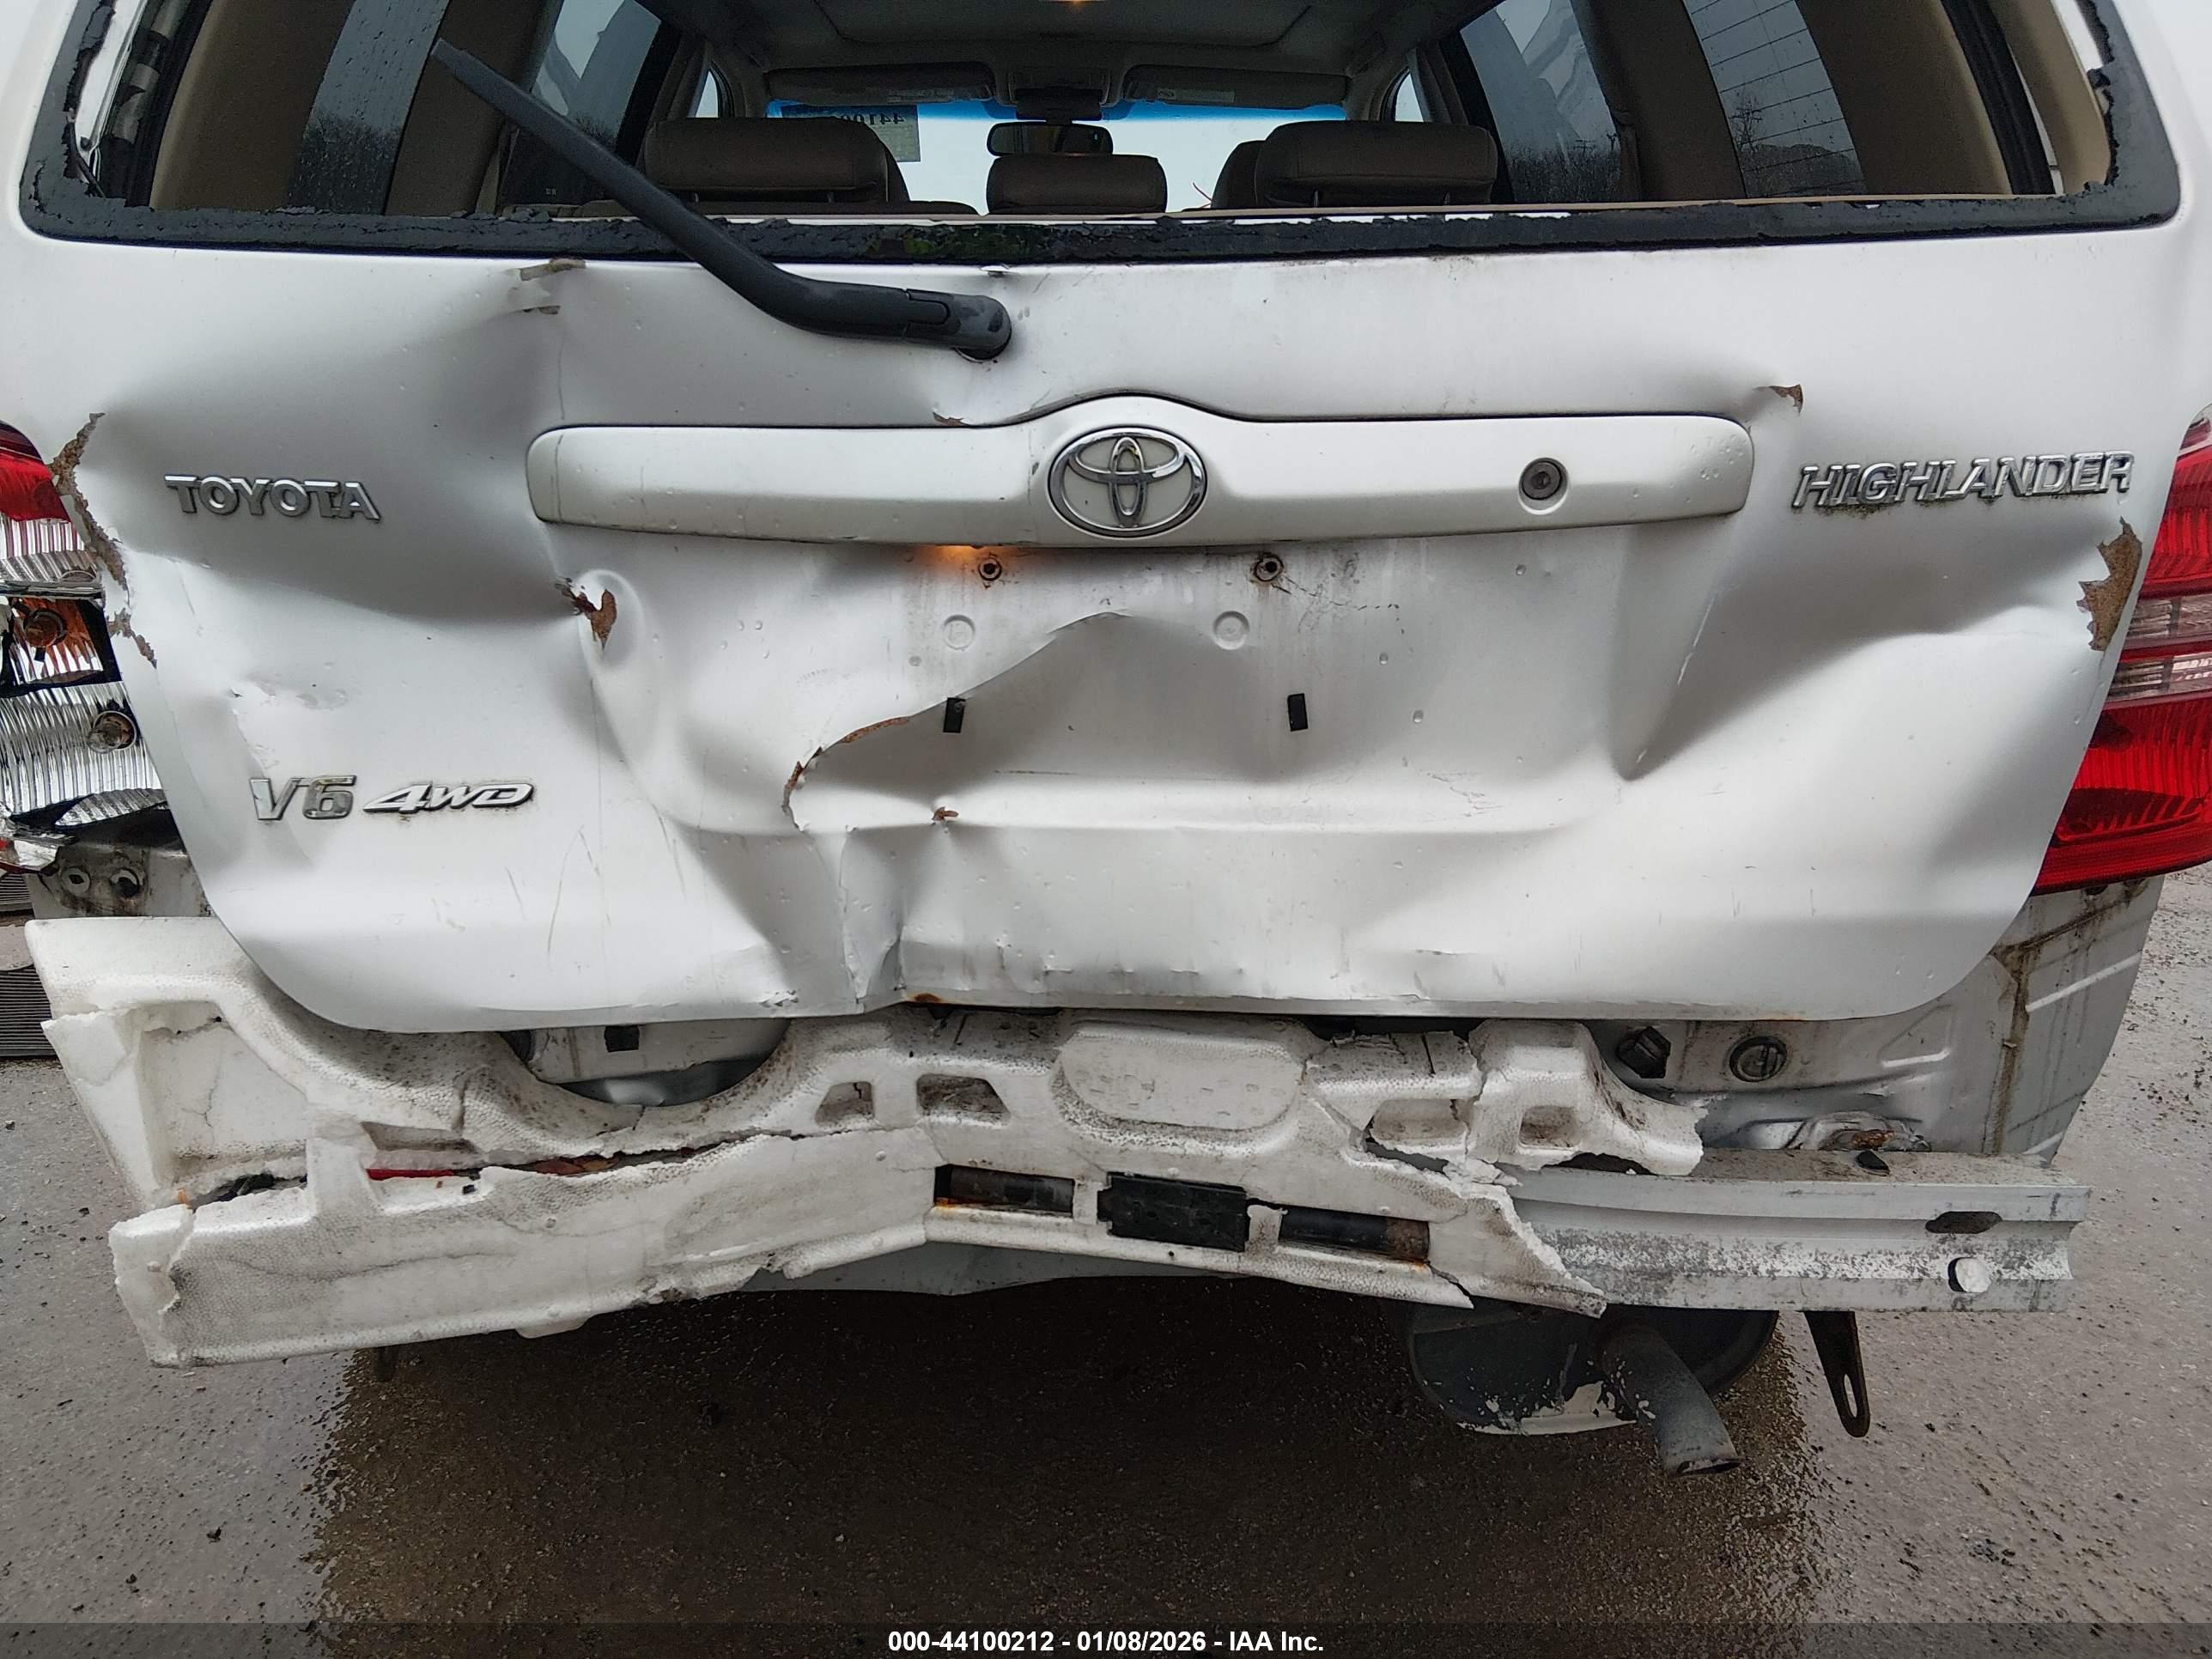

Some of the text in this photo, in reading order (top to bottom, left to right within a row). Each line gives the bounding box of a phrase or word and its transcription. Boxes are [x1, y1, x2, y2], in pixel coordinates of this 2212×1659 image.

[164, 474, 381, 522] TOYOTA
[1791, 451, 2135, 509] HIGHLANDER
[249, 775, 535, 820] V6 4WD
